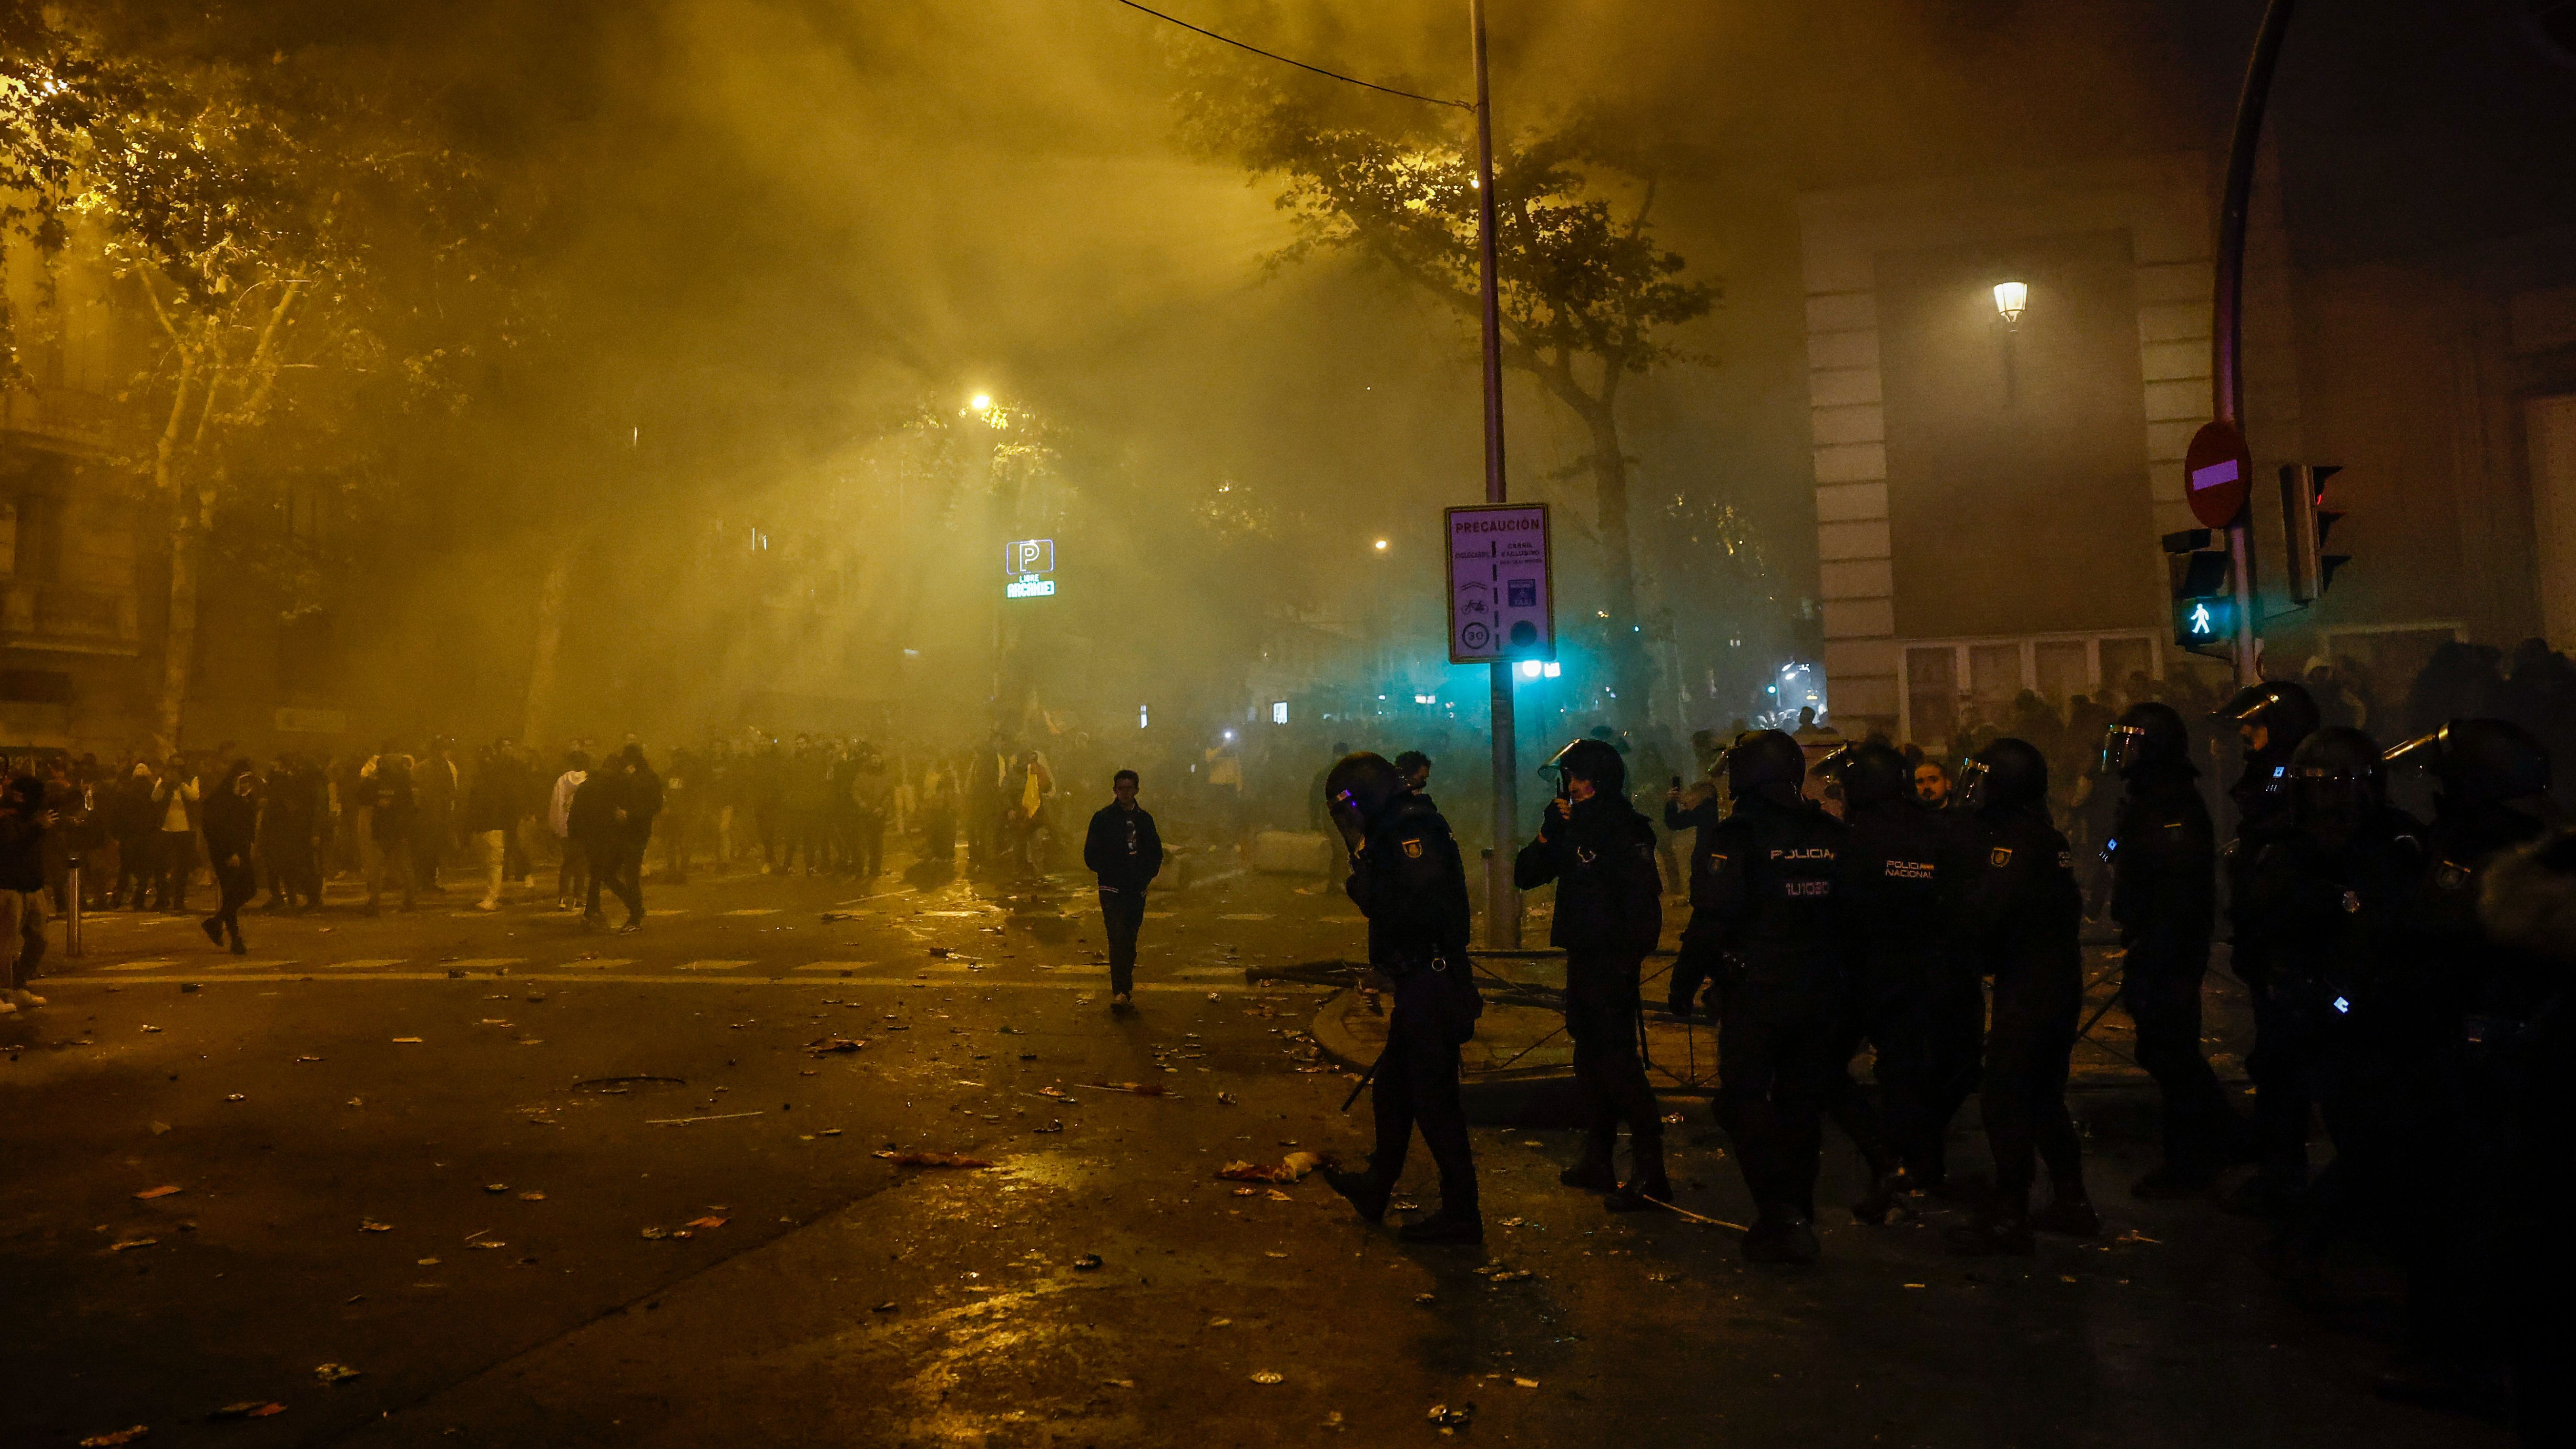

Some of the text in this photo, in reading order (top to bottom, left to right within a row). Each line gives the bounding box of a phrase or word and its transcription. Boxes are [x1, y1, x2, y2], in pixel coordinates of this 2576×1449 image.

[1456, 517, 1539, 533] PRECAUCIÓN
[1019, 542, 1039, 572] P
[1501, 549, 1540, 557] EXCLUSIVO
[1019, 573, 1039, 583] LIBRE
[1468, 631, 1484, 641] 30
[1885, 869, 1933, 878] NACIONAL
